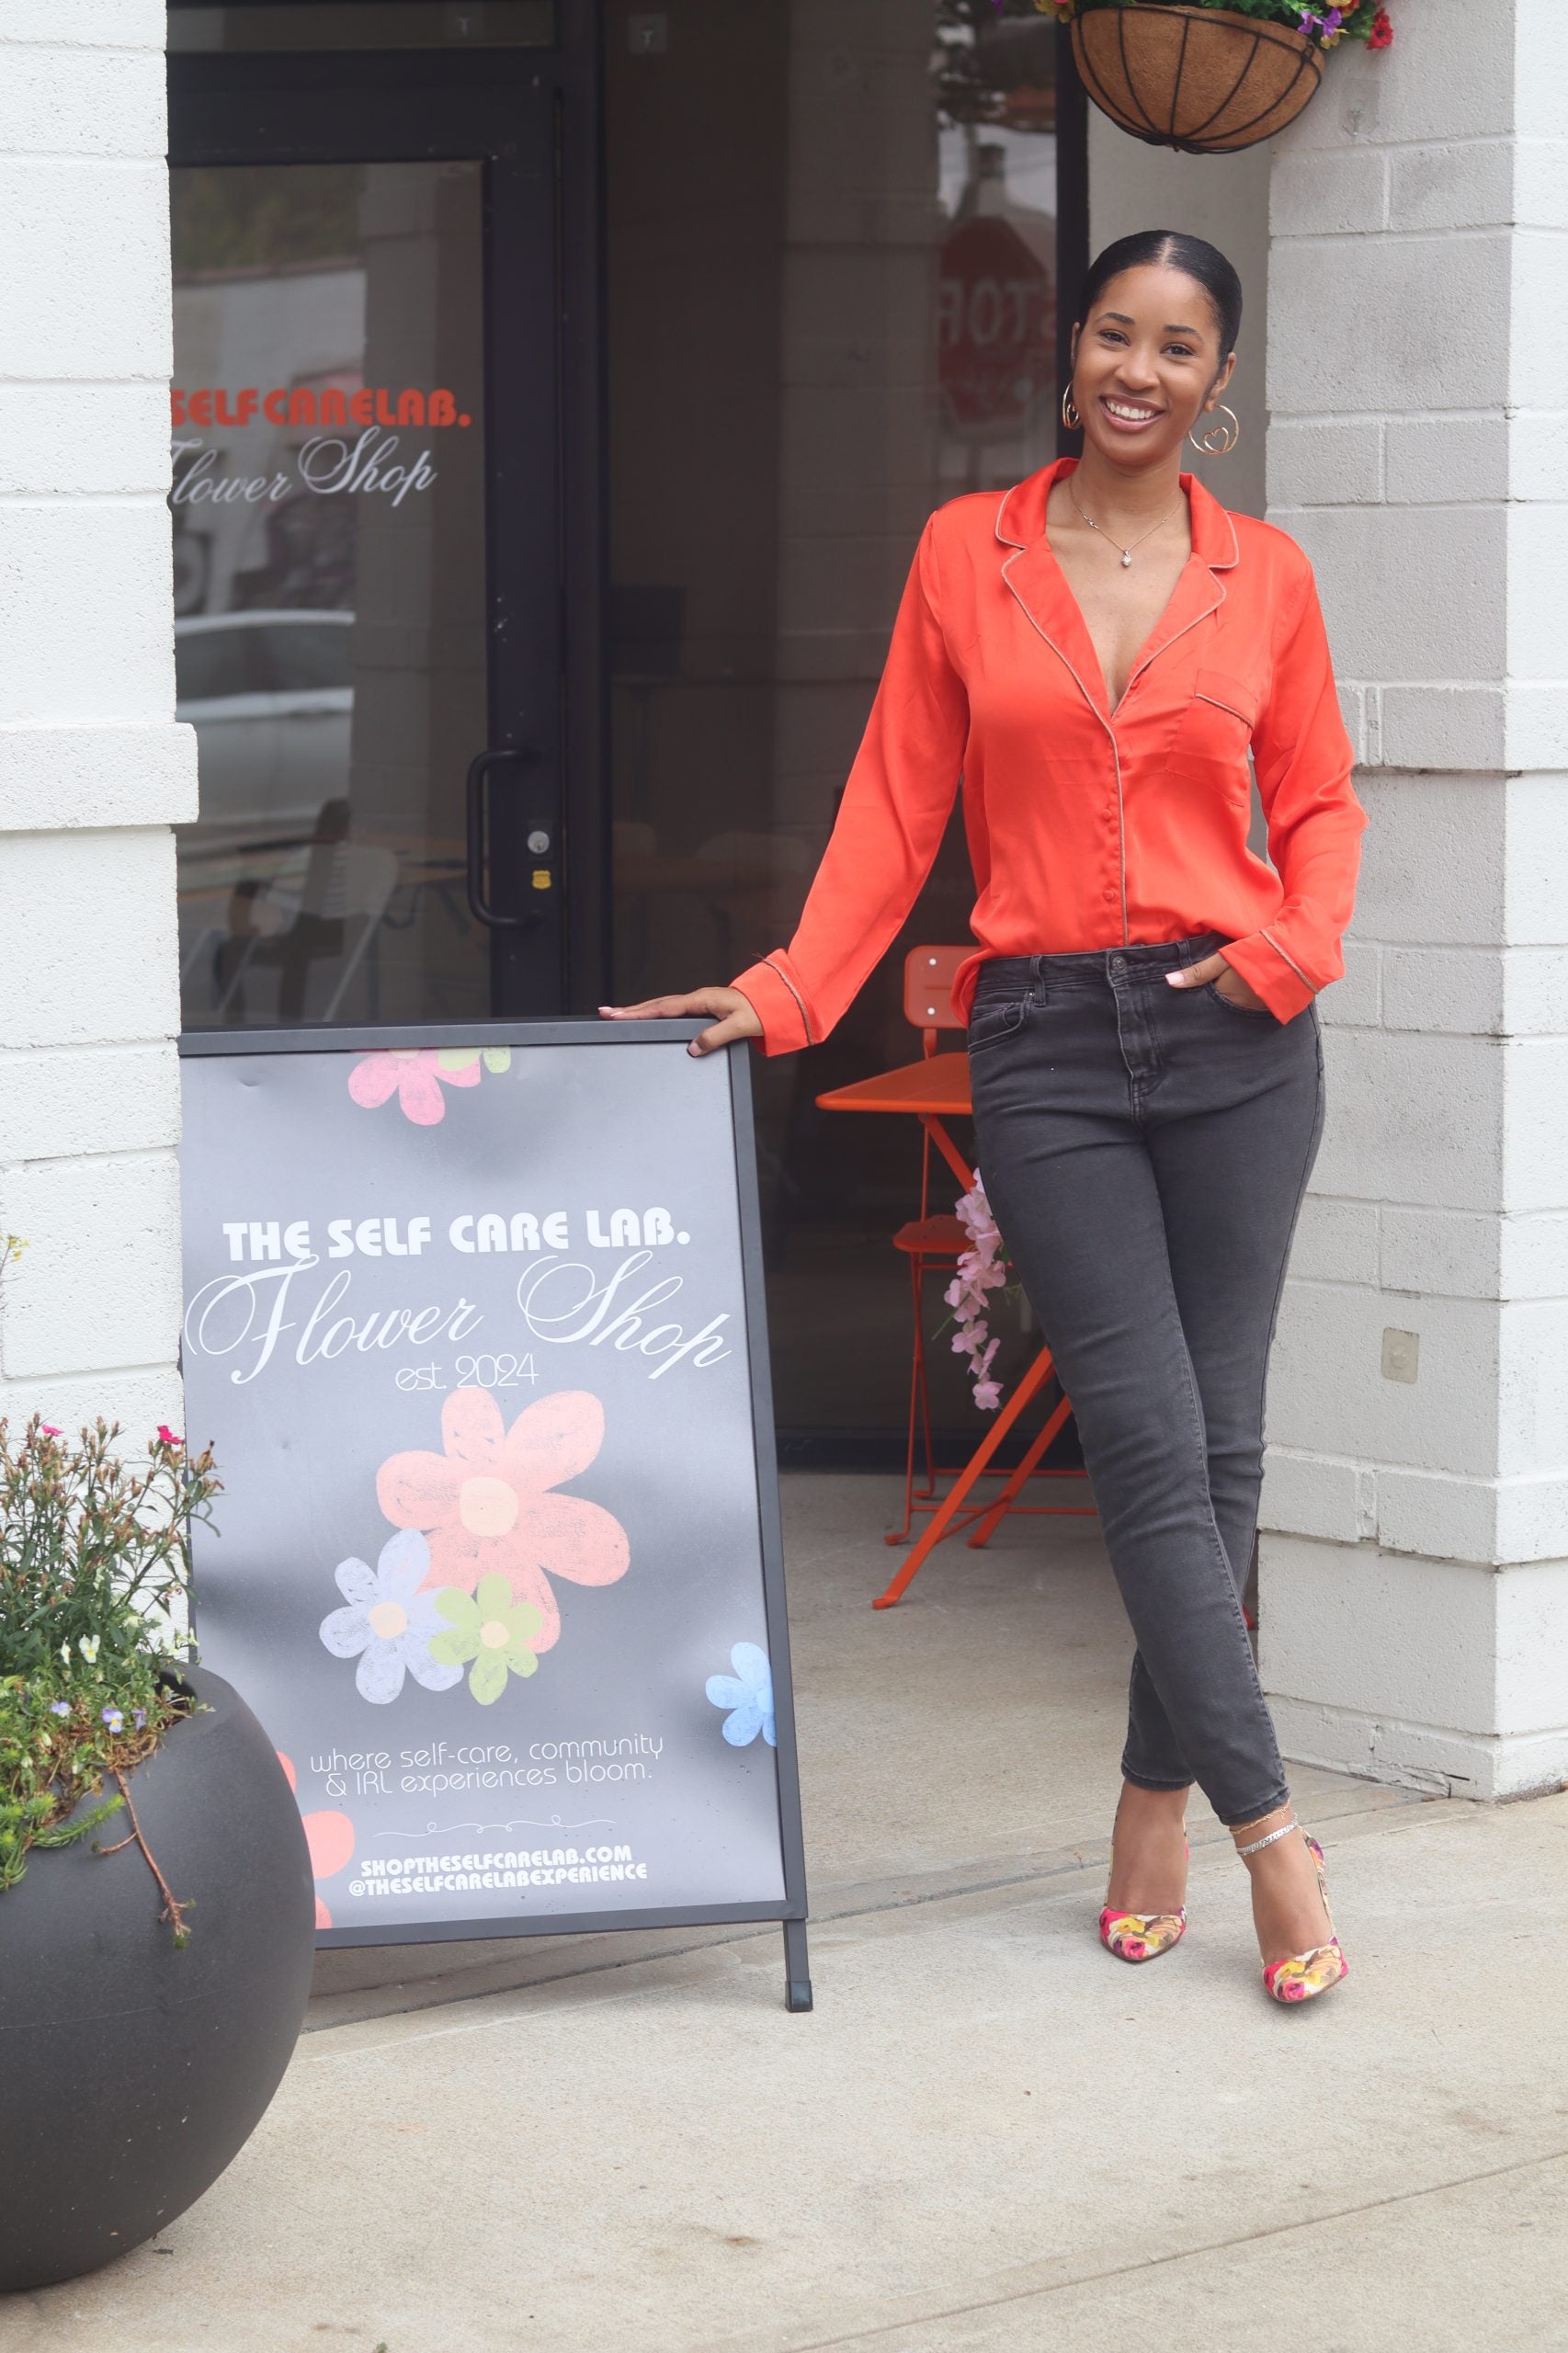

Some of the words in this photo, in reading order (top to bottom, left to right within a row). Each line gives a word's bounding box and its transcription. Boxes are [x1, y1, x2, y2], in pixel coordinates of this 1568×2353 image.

[298, 426, 437, 507] Shop
[222, 1221, 314, 1261] THE
[327, 1216, 431, 1258] SELF
[449, 1211, 569, 1253] CARE
[585, 1207, 690, 1247] LAB.
[184, 1254, 483, 1385] Flower
[517, 1250, 733, 1379] Shop
[395, 1361, 447, 1391] est.
[456, 1353, 540, 1389] 2024
[311, 1748, 392, 1773] where
[401, 1743, 517, 1768] self-care,
[529, 1733, 663, 1761] community
[326, 1773, 347, 1796] &
[357, 1770, 392, 1794] IRL
[401, 1767, 556, 1798] experiences
[566, 1760, 653, 1783] bloom.
[348, 1862, 647, 1896] @THESELFCARELABEXPERIENCE
[361, 1845, 632, 1877] SHOPTHESELFCARELAB.COM
